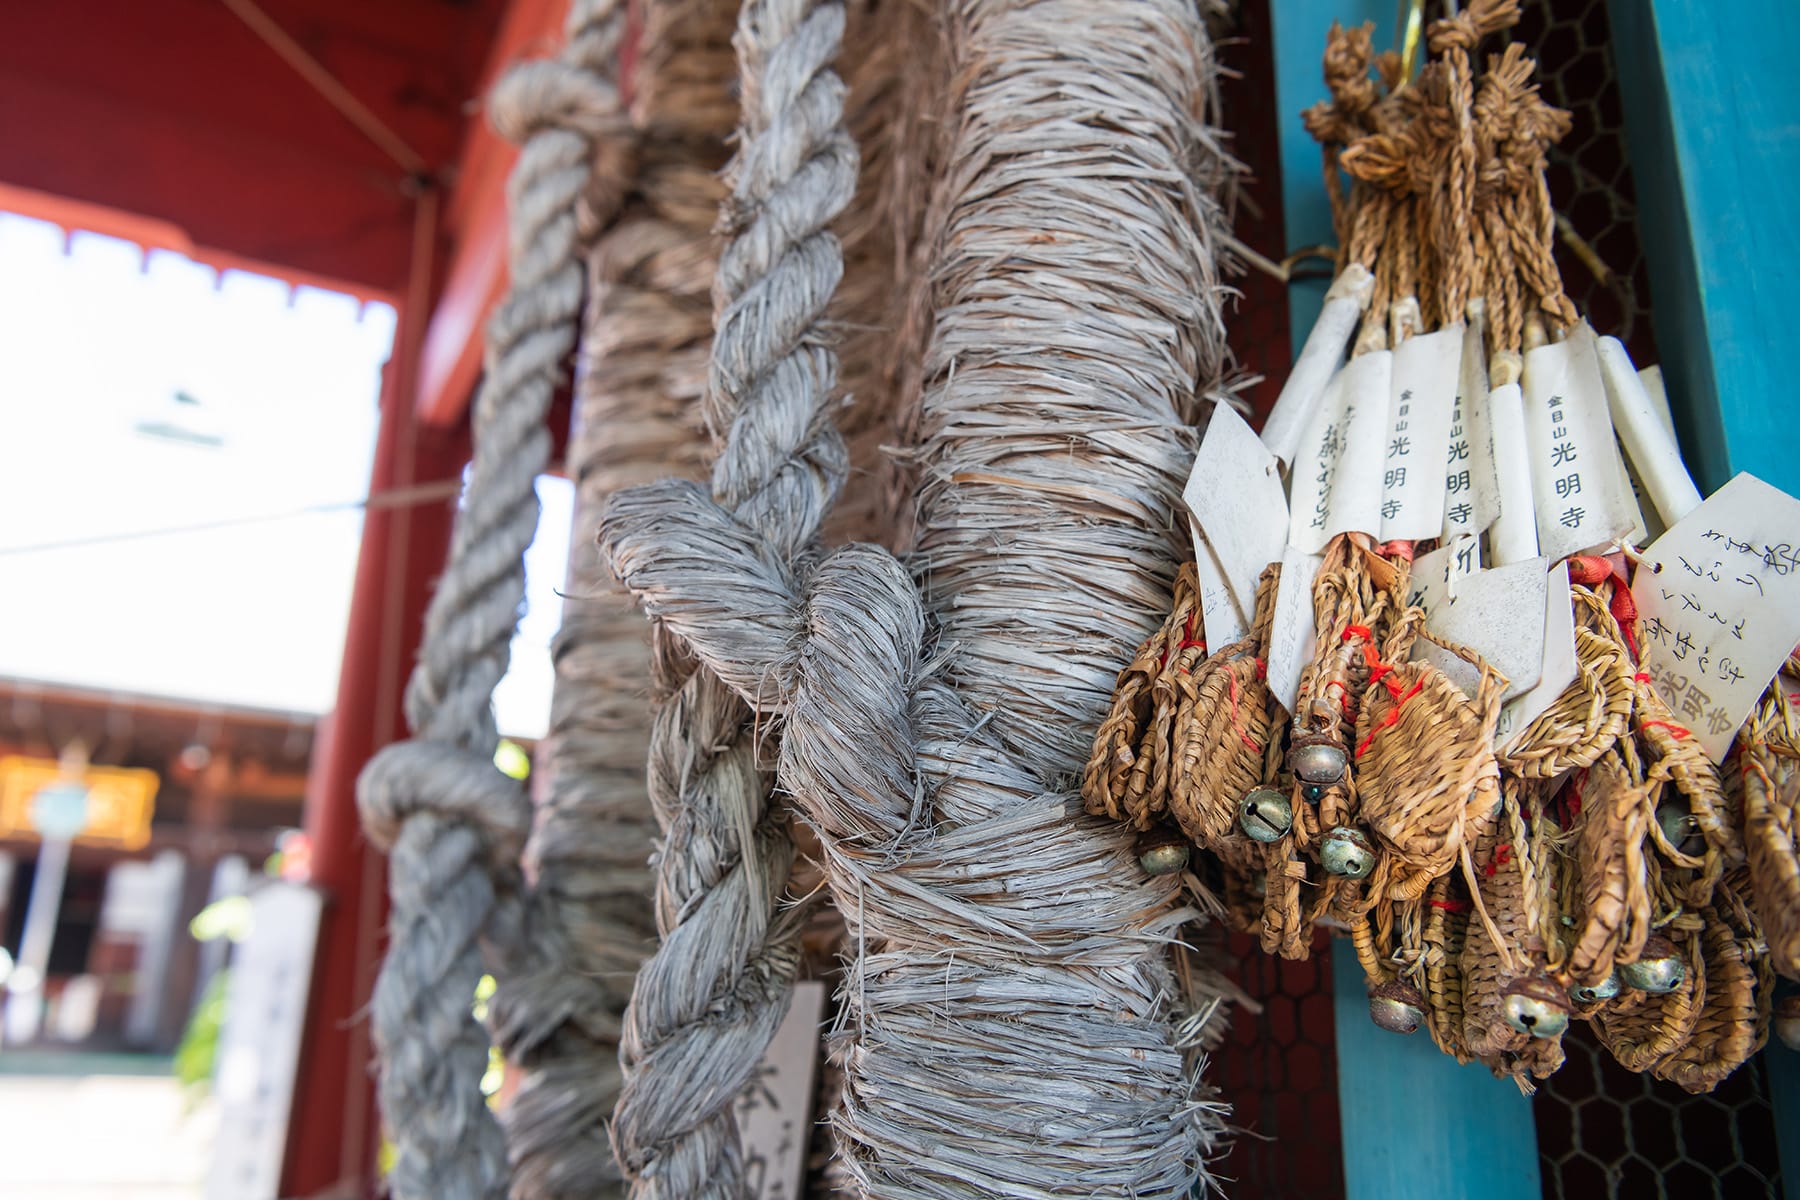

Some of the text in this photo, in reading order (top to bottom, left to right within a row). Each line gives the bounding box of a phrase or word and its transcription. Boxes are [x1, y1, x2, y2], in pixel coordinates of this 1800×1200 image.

[1547, 395, 1586, 529] 金目山光明寺
